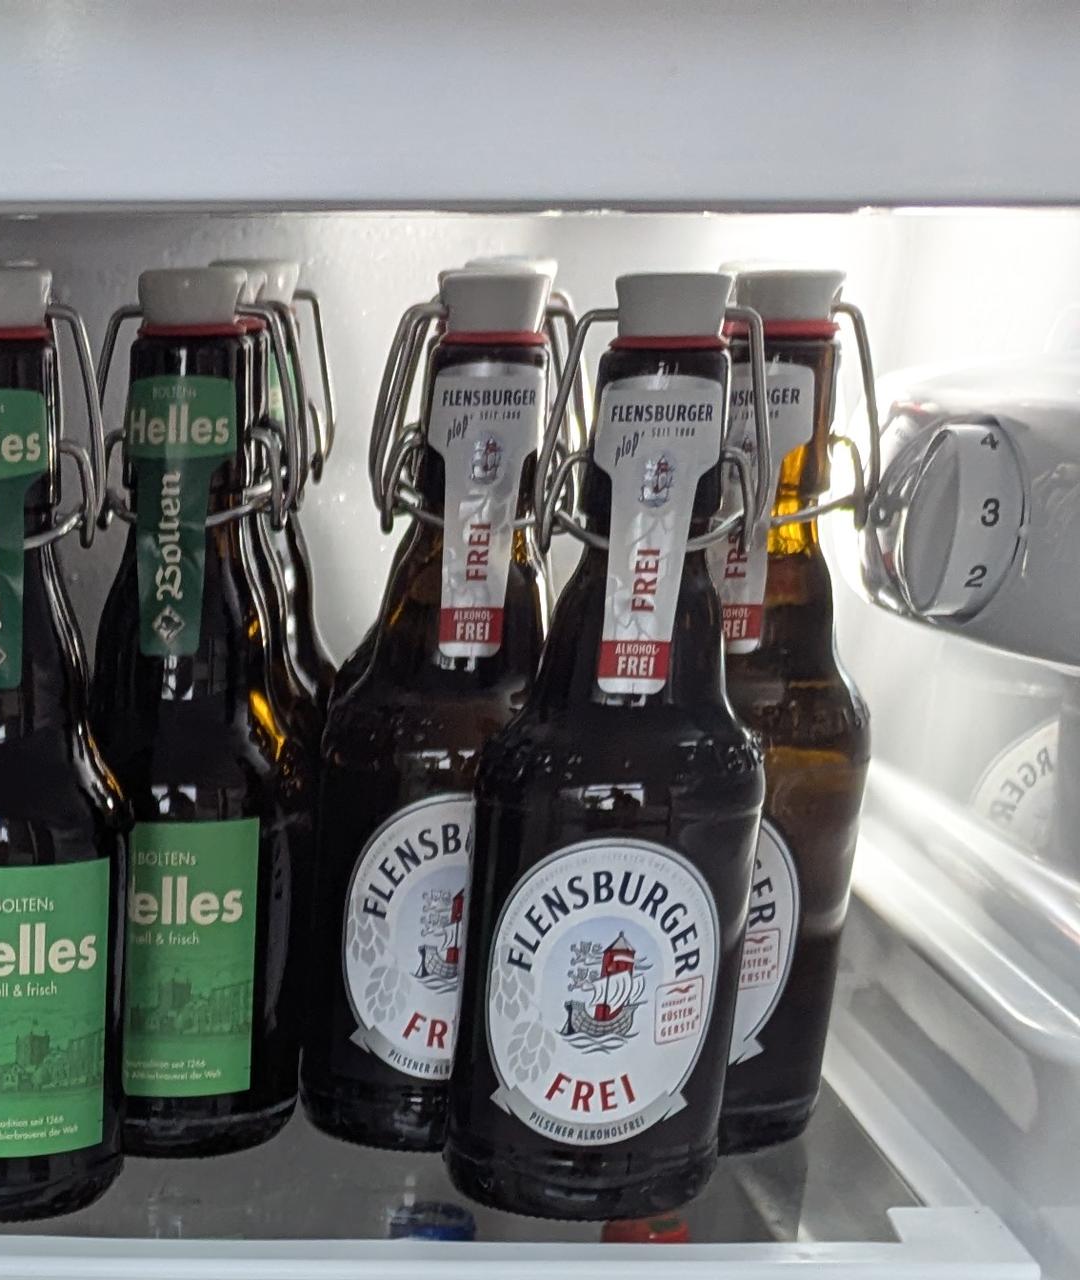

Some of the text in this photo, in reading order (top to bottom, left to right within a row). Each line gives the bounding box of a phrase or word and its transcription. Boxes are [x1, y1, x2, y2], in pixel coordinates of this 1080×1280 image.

[442, 388, 537, 406] FLENSBURGER
[130, 403, 230, 446] Helles
[611, 404, 714, 423] FLENSBURGER
[980, 432, 1000, 451] 4
[981, 497, 1001, 527] 3
[466, 523, 491, 581] FREI
[631, 548, 661, 613] FREI
[965, 565, 988, 588] 2
[456, 621, 490, 641] FREI
[617, 656, 655, 676] FREI
[363, 822, 474, 920] FLENSB
[127, 875, 243, 926] elles
[169, 930, 200, 945] frisch
[507, 870, 700, 978] FLENSBURGER
[13, 985, 22, 997] &
[27, 981, 57, 997] frisch
[402, 1011, 456, 1050] FR
[545, 1072, 636, 1113] FREI
[529, 1111, 645, 1142] PILSENER ALKOHOLFREI
